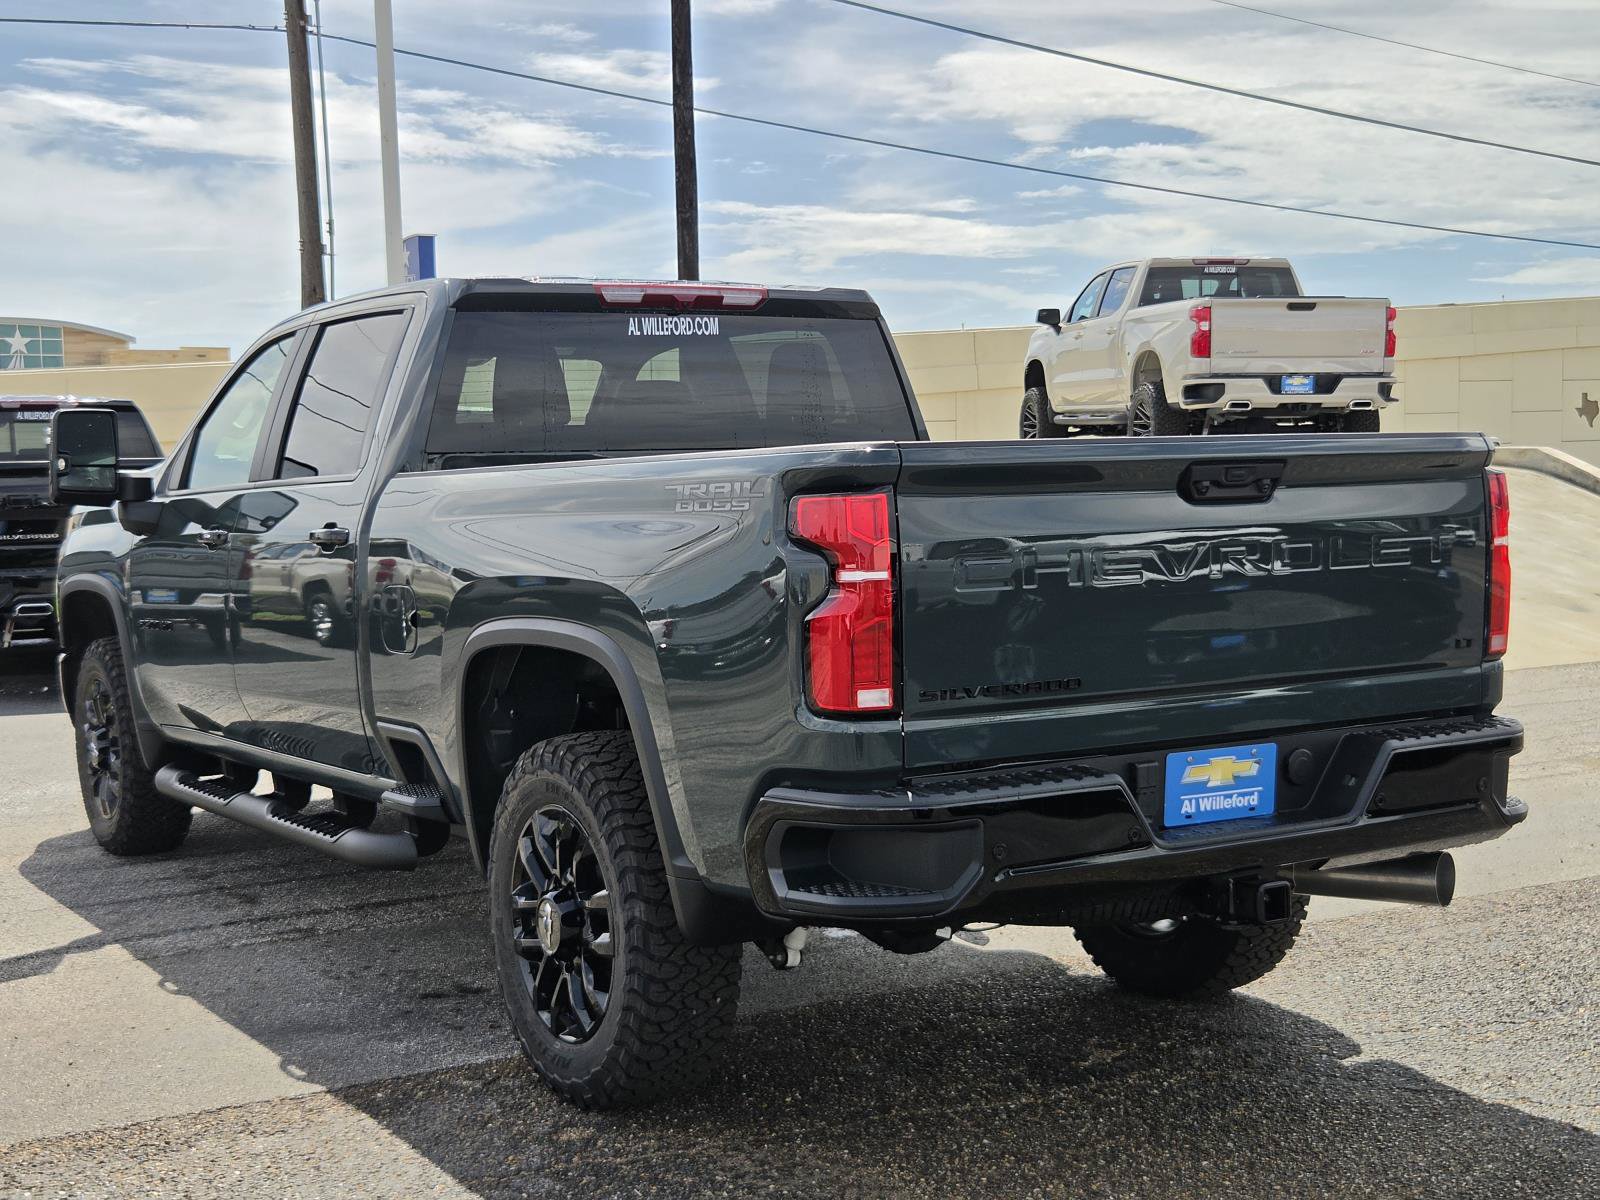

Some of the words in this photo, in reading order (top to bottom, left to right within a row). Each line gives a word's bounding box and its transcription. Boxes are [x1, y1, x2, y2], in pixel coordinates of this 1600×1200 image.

[628, 317, 641, 336] AL
[642, 317, 719, 336] WILLEFORD.COM
[664, 480, 765, 499] TRAIL
[675, 498, 751, 513] BOSS
[953, 533, 1456, 592] CHEVROLET
[918, 676, 1082, 703] SILVERADO
[1180, 798, 1196, 814] Al
[1198, 792, 1258, 812] Willeford
